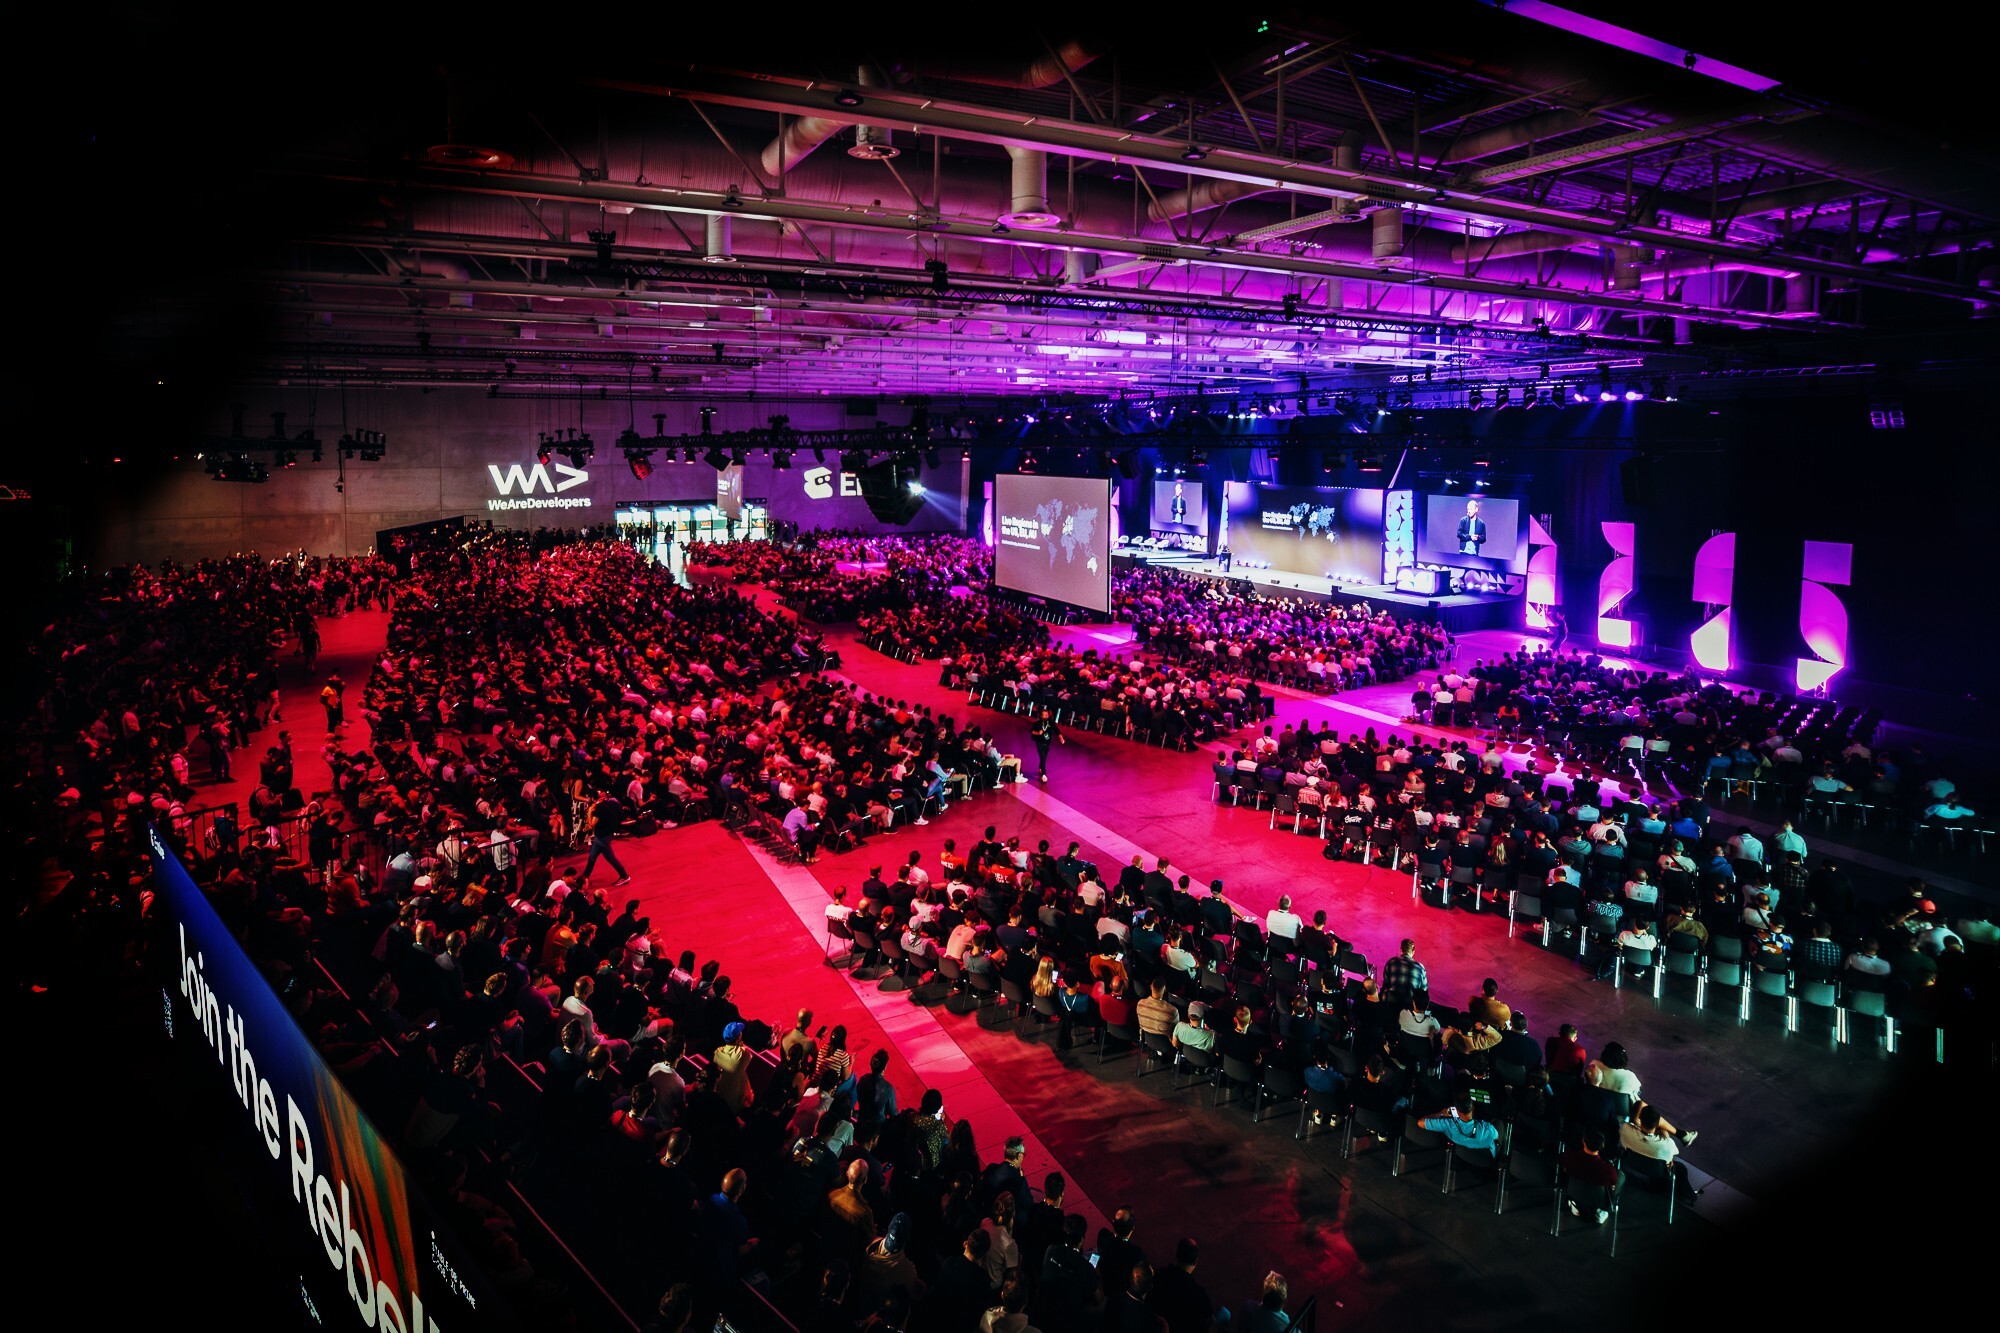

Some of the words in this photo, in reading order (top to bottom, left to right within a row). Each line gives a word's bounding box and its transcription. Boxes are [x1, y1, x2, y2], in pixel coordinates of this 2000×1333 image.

[840, 472, 863, 496] E
[487, 496, 591, 511] WeAreDevelopers
[179, 922, 224, 1065] Join
[227, 1004, 281, 1159] the
[288, 1094, 440, 1333] Rebe
